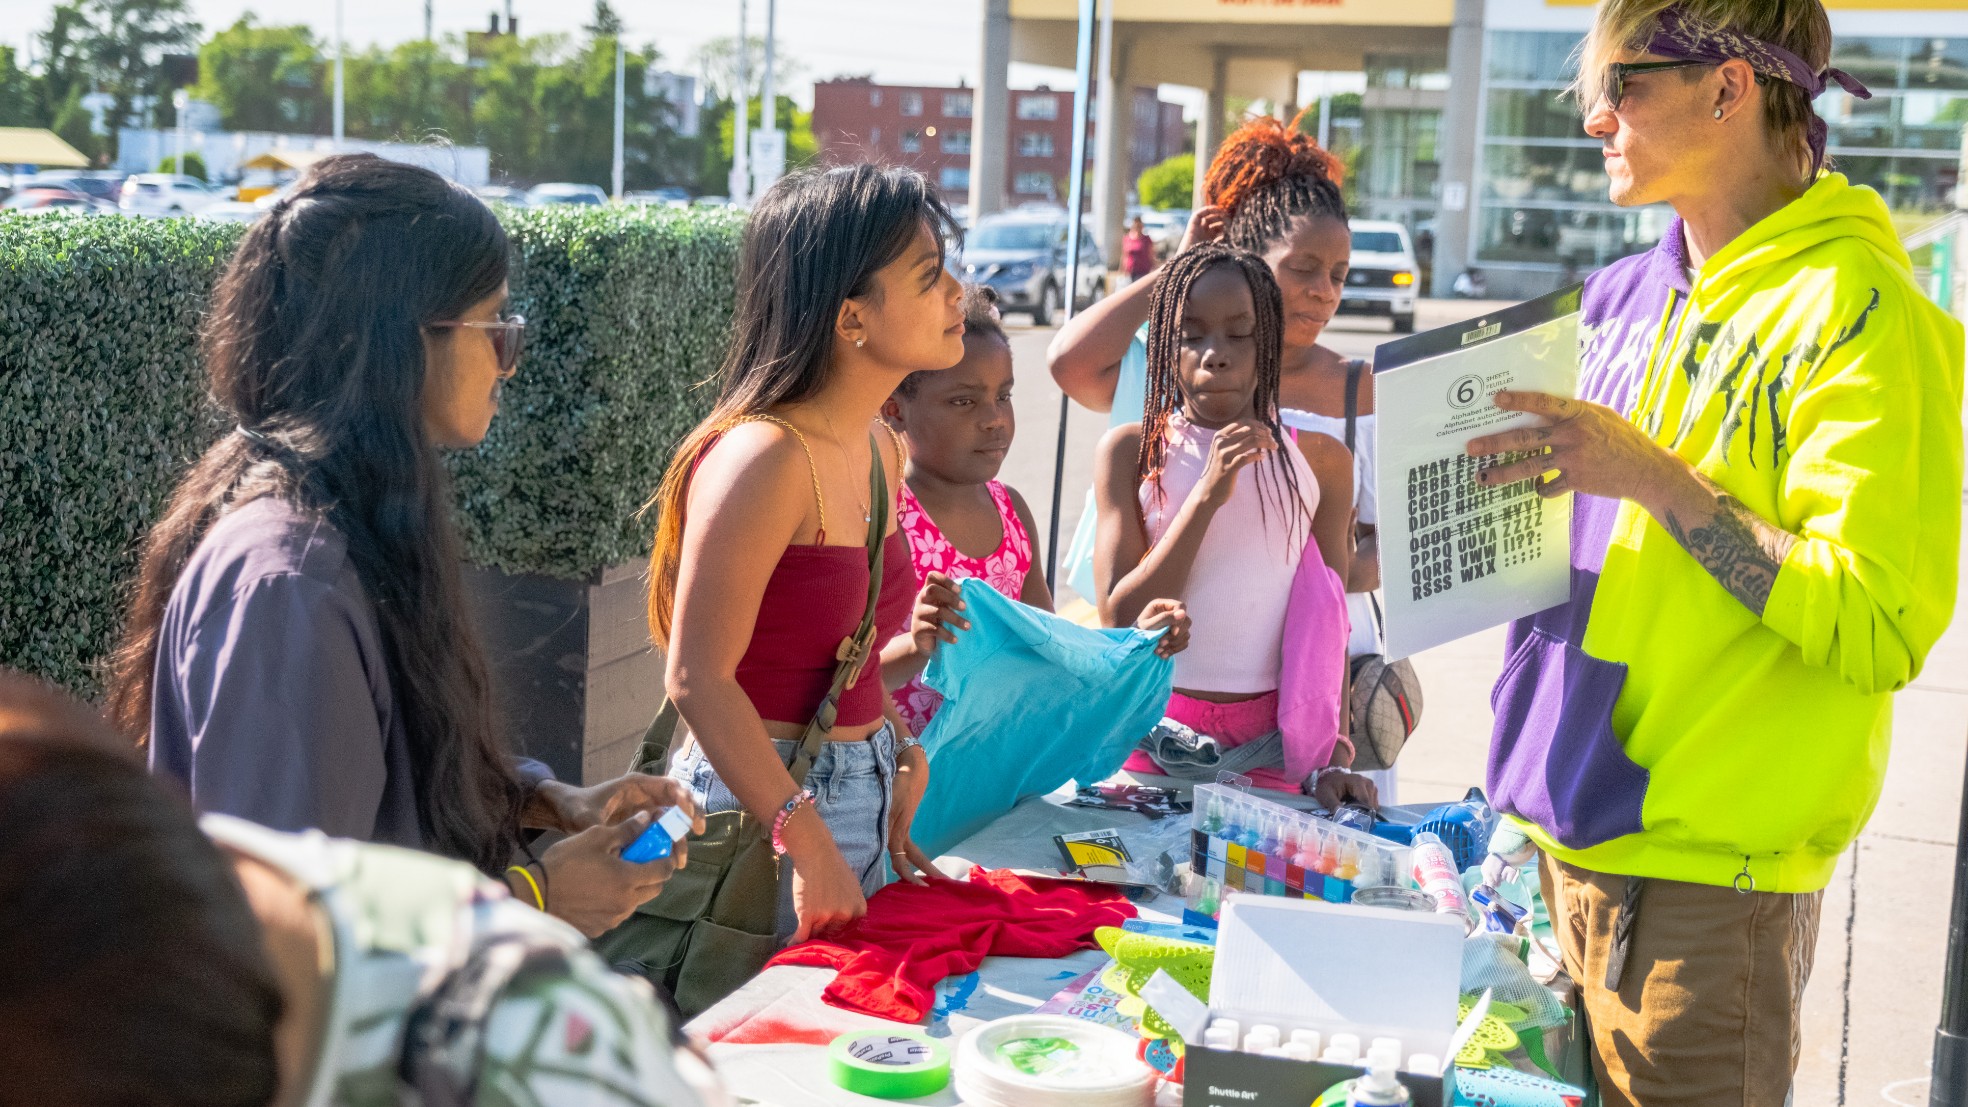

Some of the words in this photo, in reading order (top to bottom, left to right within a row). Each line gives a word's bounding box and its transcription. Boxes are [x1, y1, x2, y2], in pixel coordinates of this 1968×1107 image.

[1485, 370, 1510, 382] SHEETS
[1485, 376, 1514, 390] FEUILLES
[1456, 379, 1474, 404] 6
[1443, 417, 1476, 429] Alphabet
[1476, 407, 1511, 421] autocolla
[1450, 408, 1482, 421] Alphabet
[1483, 403, 1499, 412] Stic
[1482, 418, 1494, 426] del
[1495, 411, 1523, 423] alfabeto
[1208, 1085, 1240, 1098] Shuttle
